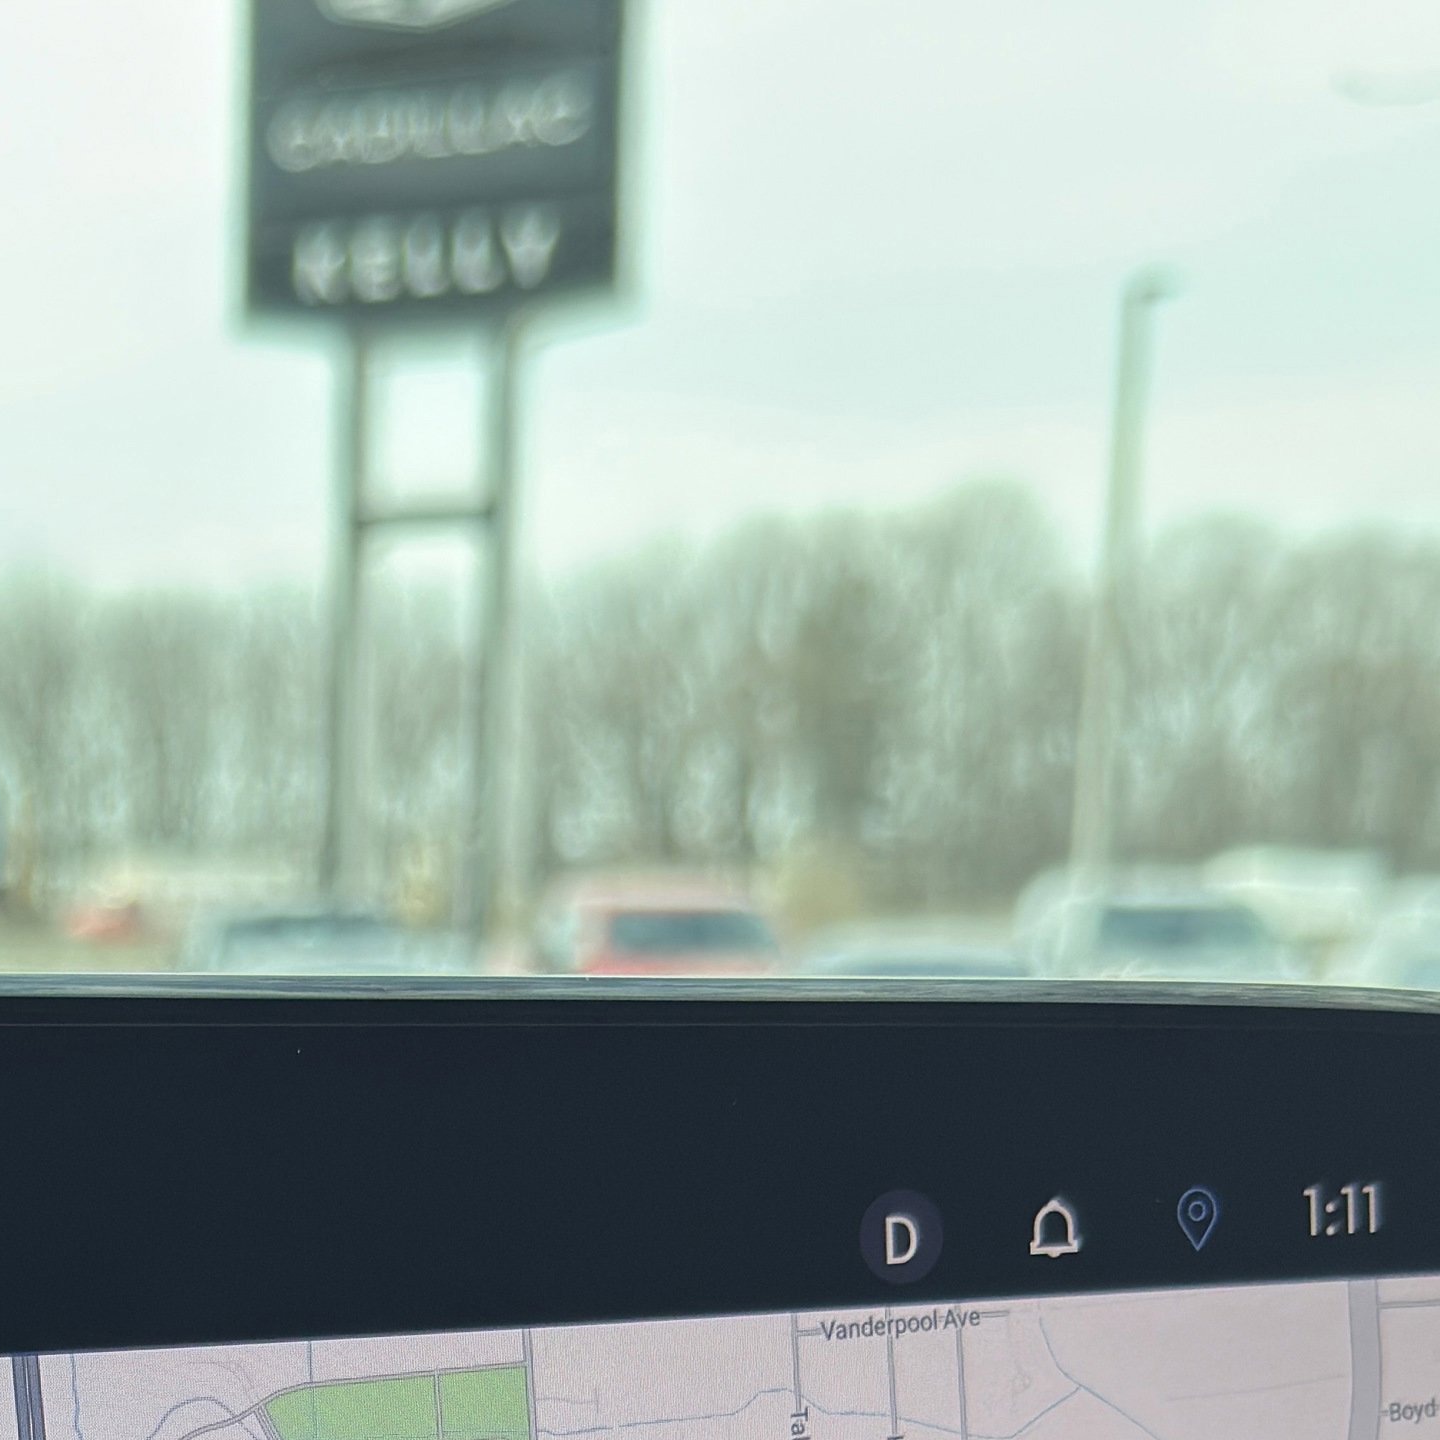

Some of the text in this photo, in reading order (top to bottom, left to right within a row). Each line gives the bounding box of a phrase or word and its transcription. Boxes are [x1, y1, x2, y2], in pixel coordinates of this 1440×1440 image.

[293, 202, 560, 305] KELLY
[1302, 1185, 1381, 1238] 1:11
[884, 1216, 918, 1266] D
[820, 1309, 980, 1341] Vanderpool Ave
